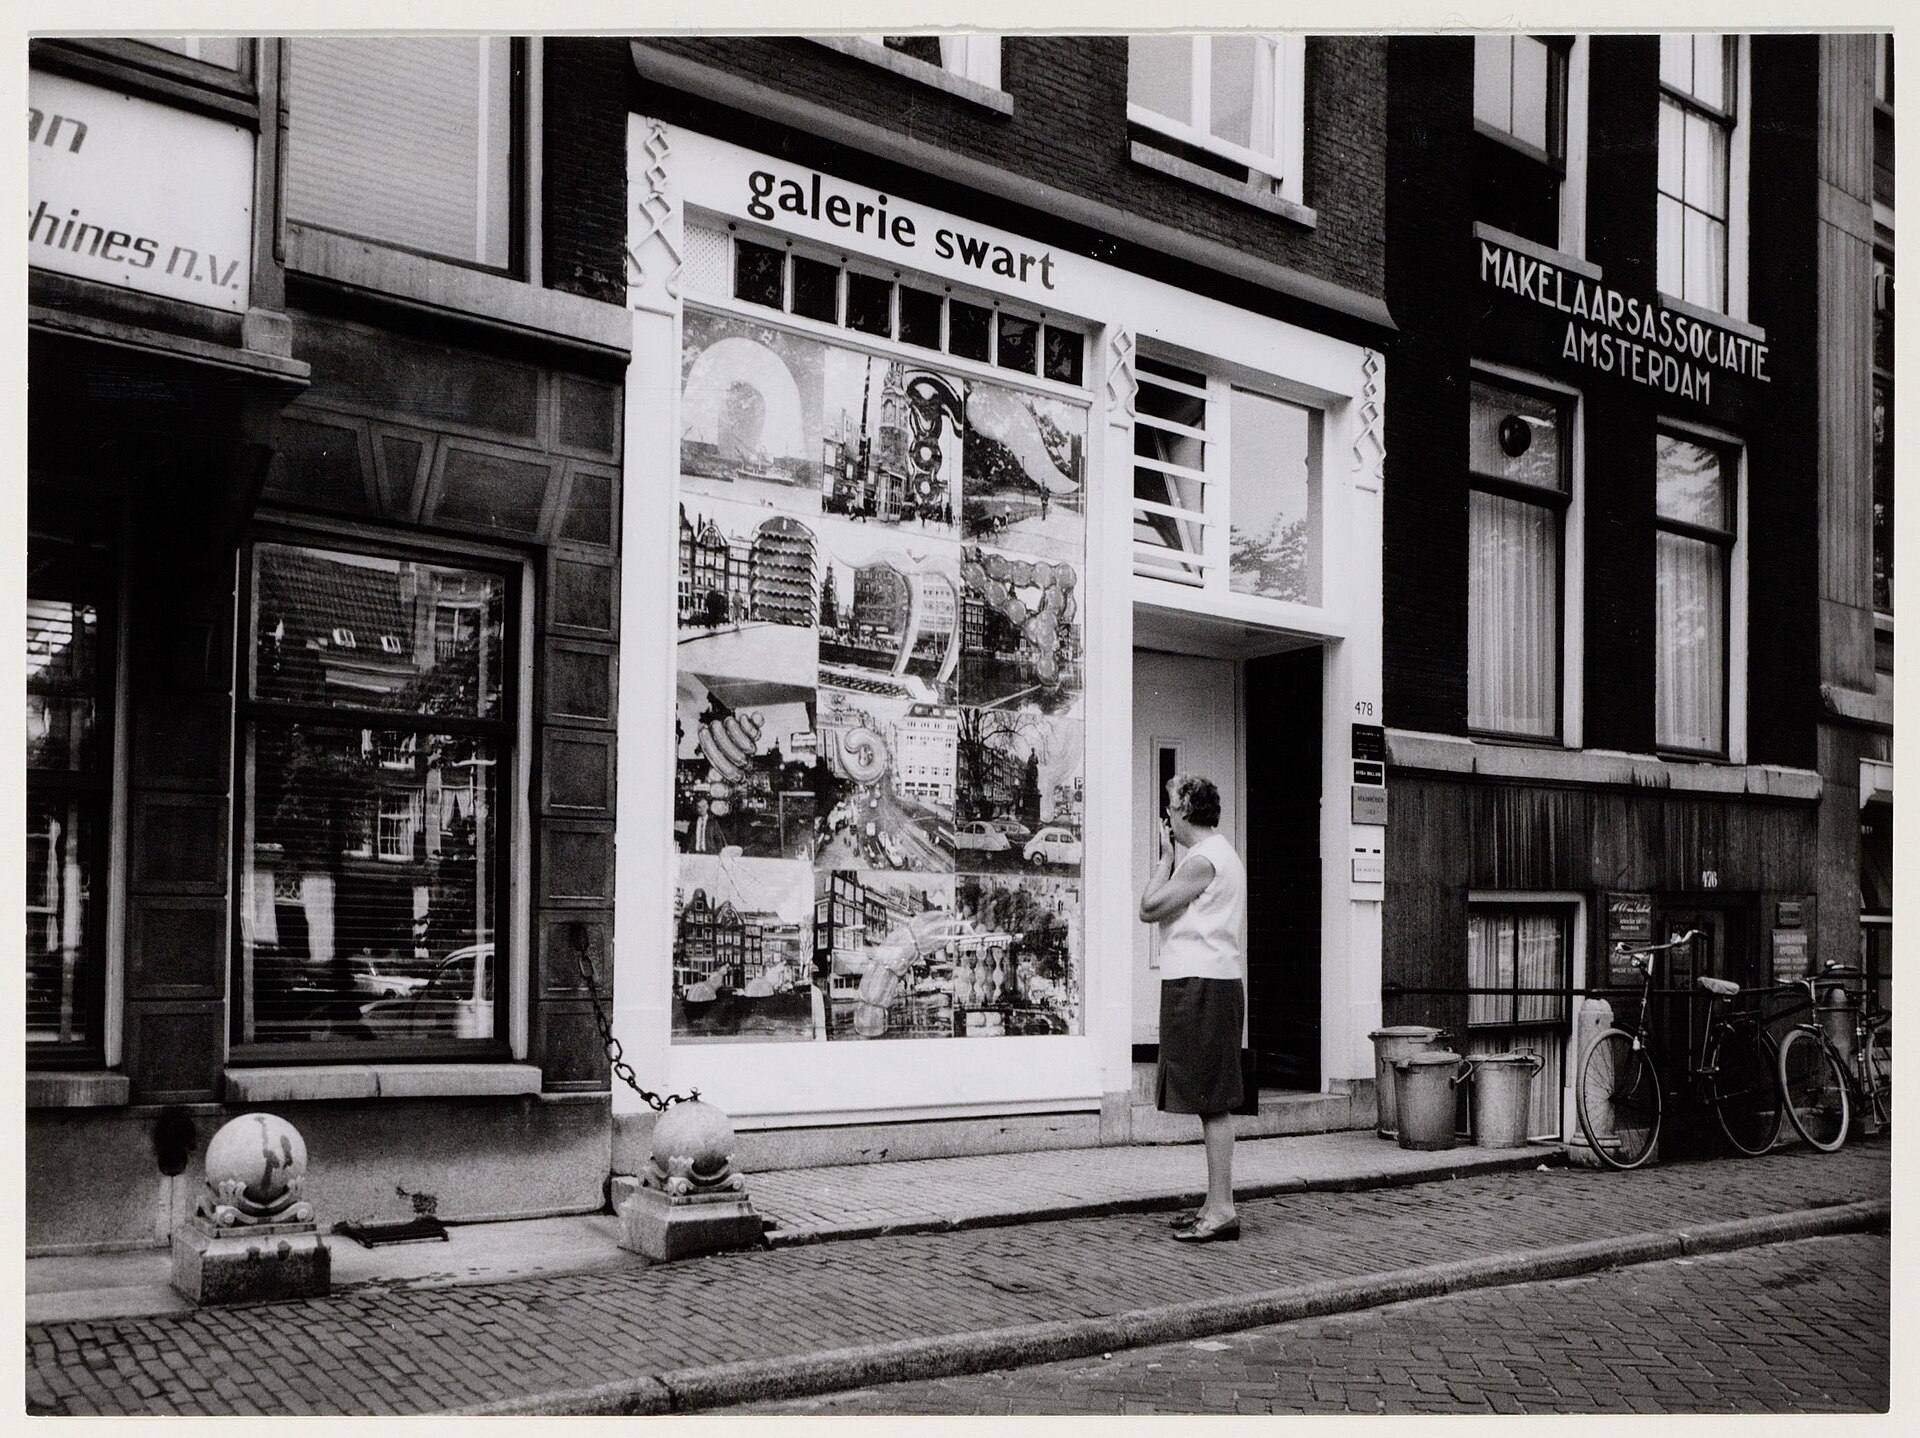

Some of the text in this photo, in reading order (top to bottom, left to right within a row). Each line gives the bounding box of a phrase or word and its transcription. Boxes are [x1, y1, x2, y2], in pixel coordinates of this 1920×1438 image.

[28, 200, 159, 269] hines
[747, 170, 1055, 290] galerie swart
[1480, 241, 1771, 383] MAKELAARSASSOCIATIE
[1562, 321, 1710, 406] AMSTERDAM
[1354, 701, 1374, 717] 478
[1701, 870, 1718, 888] 476
